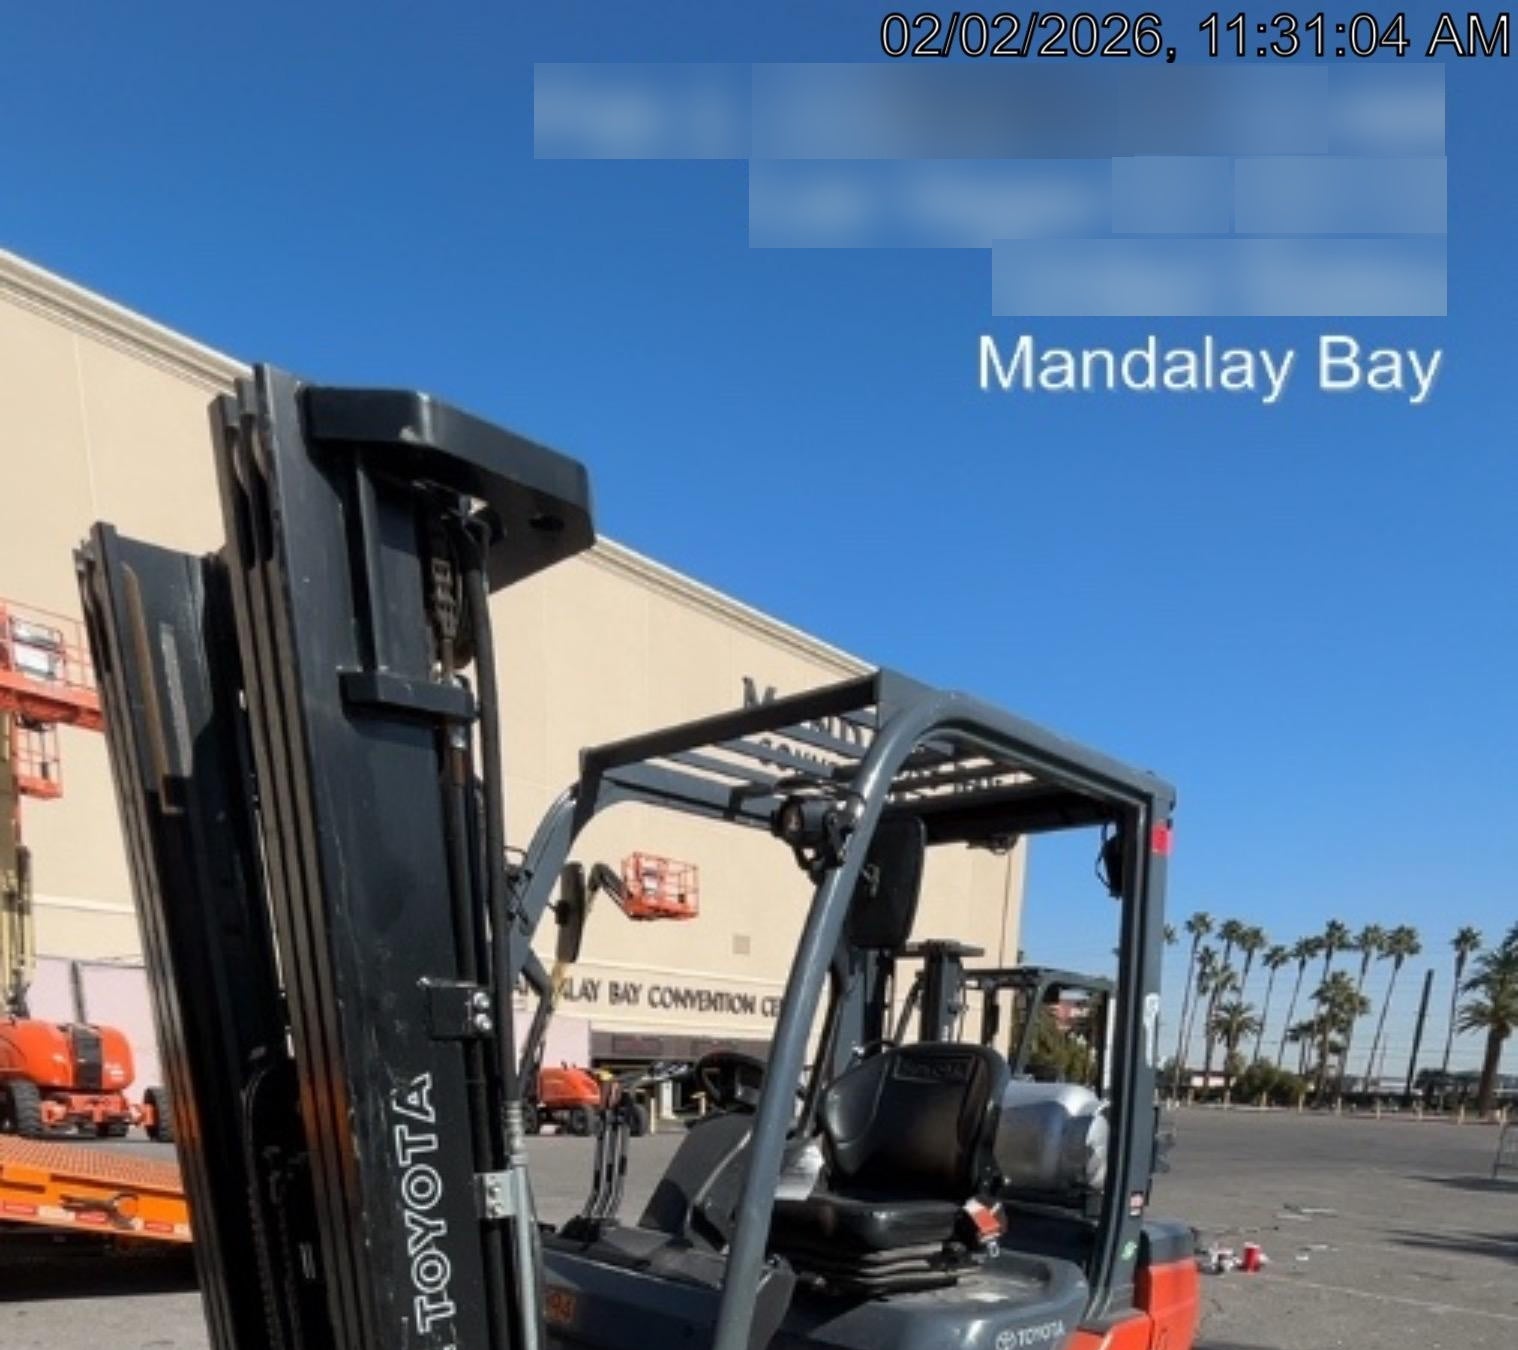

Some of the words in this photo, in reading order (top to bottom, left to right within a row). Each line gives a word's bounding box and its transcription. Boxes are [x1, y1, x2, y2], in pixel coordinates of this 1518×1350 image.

[608, 979, 643, 1005] BAY
[648, 985, 756, 1016] CONVENTION
[392, 1071, 456, 1336] TOYOTA
[1017, 1319, 1066, 1348] TOYOTA
